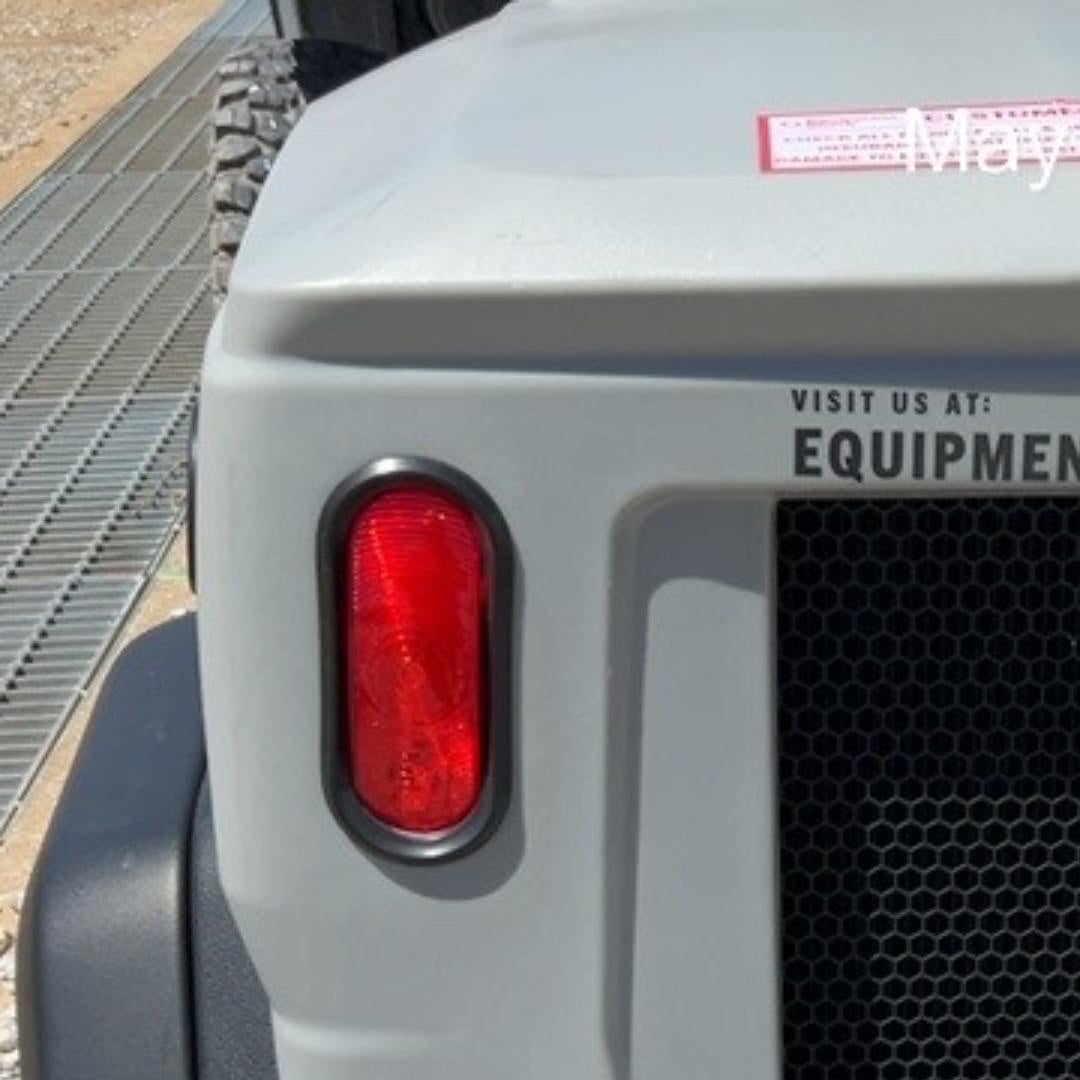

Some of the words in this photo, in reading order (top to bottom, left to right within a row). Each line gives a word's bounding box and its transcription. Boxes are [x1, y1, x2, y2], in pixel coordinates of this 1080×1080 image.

[791, 390, 874, 414] VISIT
[892, 391, 929, 415] US
[945, 391, 992, 416] AT:
